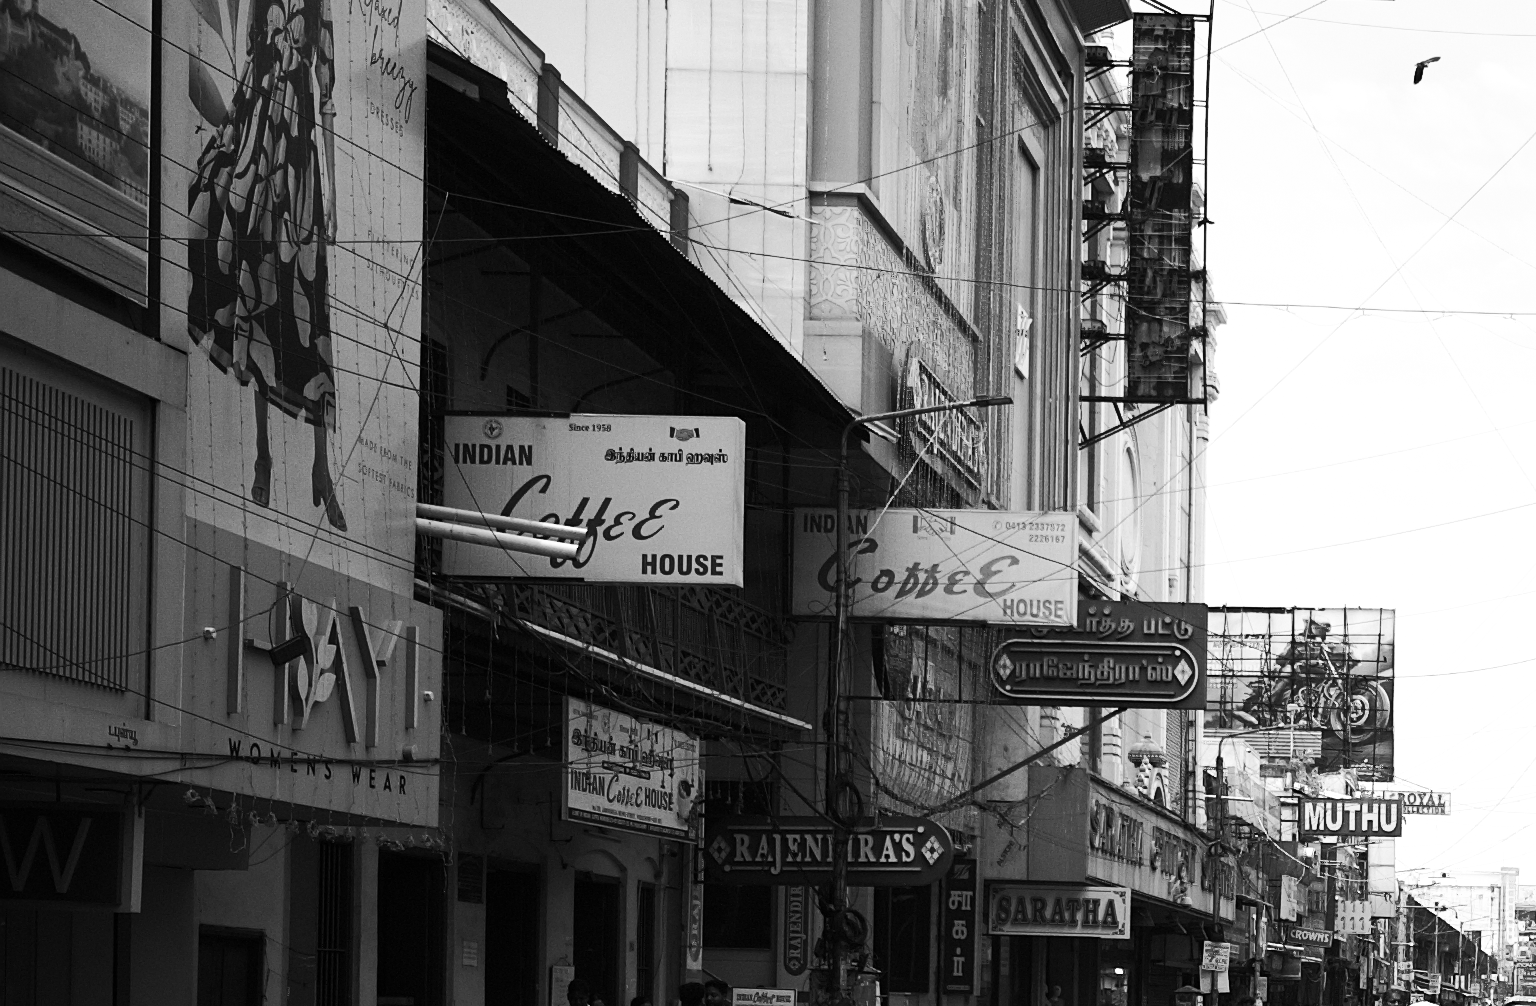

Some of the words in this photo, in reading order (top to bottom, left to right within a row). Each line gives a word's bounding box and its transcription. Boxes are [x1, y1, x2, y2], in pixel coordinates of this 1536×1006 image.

[453, 443, 533, 466] INDIAN
[803, 513, 868, 535] INDAN
[641, 554, 724, 576] HOUSE
[1003, 599, 1065, 619] HOUSE
[351, 761, 406, 795] WEAR
[1304, 802, 1398, 832] MUTHU
[996, 895, 1119, 928] SARATHA
[1290, 930, 1330, 943] CROWNS
